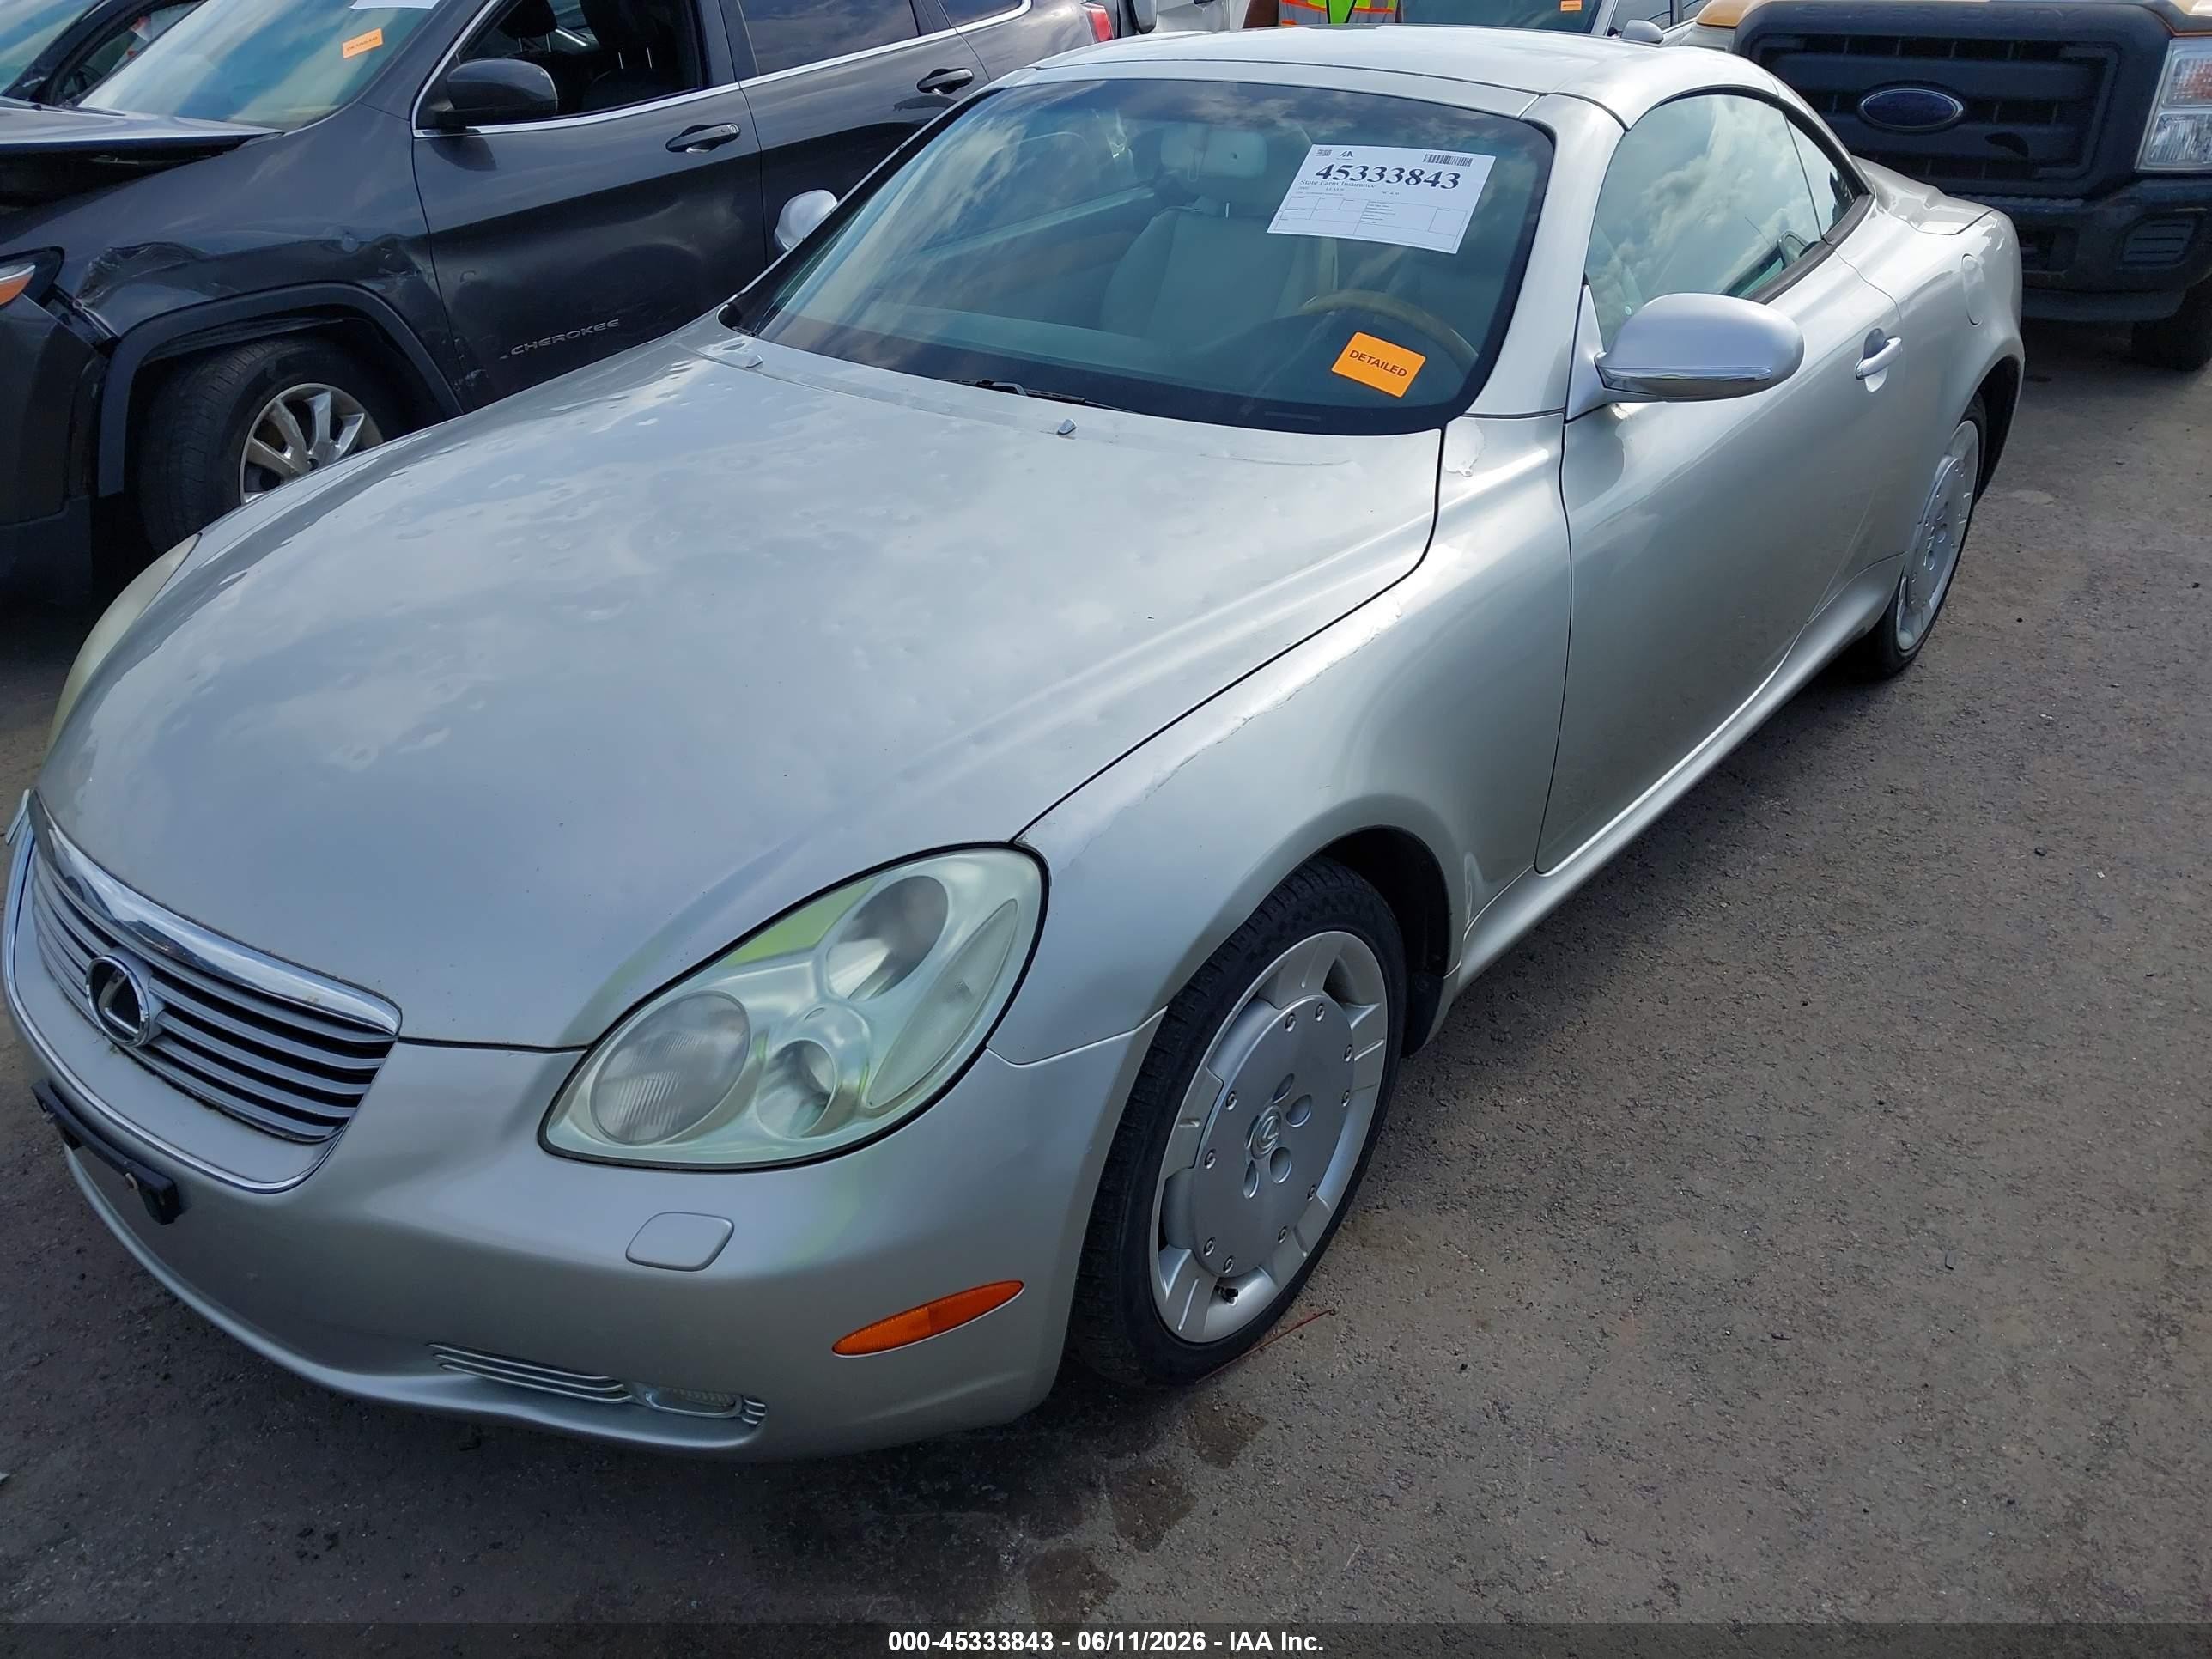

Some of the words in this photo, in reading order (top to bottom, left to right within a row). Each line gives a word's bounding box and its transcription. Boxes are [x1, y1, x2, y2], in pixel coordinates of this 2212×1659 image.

[1315, 163, 1461, 190] 45333843
[1340, 180, 1376, 189] Insurance
[510, 319, 619, 356] CHEROKEE
[1348, 349, 1407, 377] DETAILED
